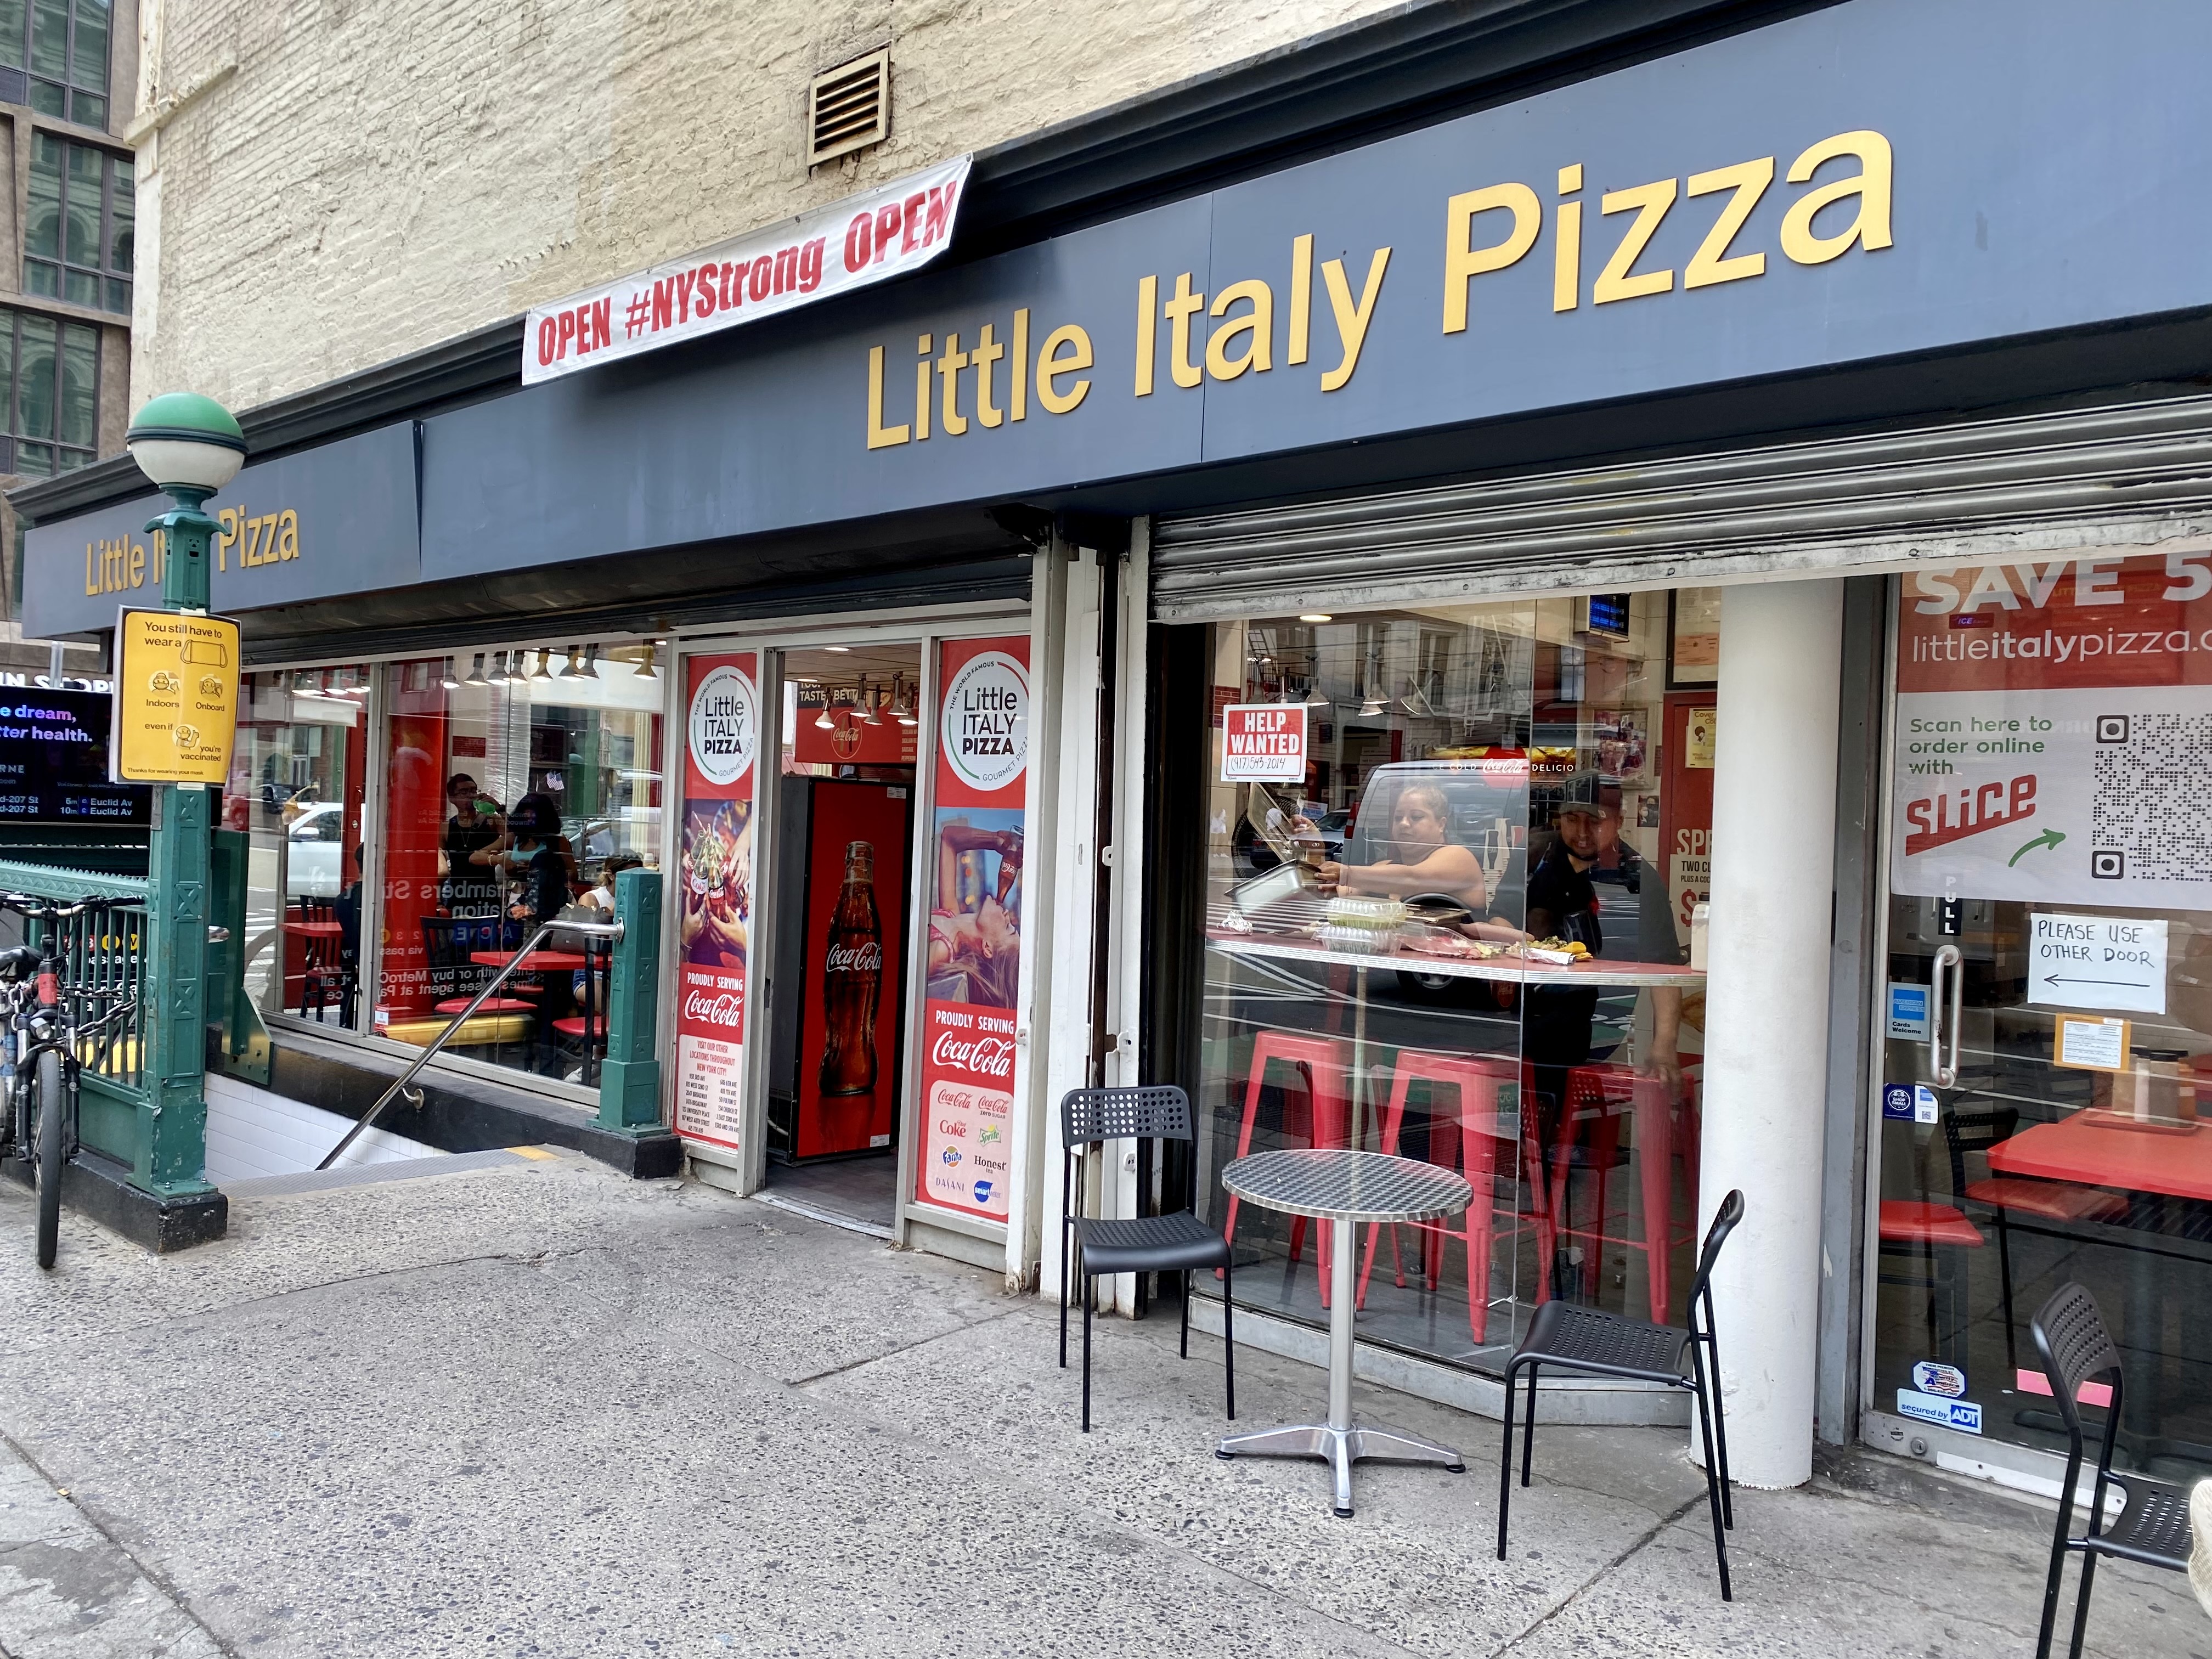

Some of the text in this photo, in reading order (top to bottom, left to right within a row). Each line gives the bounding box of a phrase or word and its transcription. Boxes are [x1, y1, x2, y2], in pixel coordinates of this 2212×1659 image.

[538, 180, 957, 366] OPEN #NYStrong OPEN
[867, 130, 1894, 450] Little Italy Pizza
[86, 534, 145, 596] Little
[219, 505, 300, 571] Pizza
[1914, 553, 2125, 615] SAVE
[145, 622, 222, 638] You still have to
[145, 637, 182, 647] wear a
[955, 672, 971, 693] WORLD
[971, 661, 994, 675] FAMOUS
[698, 684, 711, 702] WORLD
[710, 674, 727, 685] FAMOUS
[834, 689, 859, 701] BETT
[146, 699, 225, 712] Indoors Onboard
[705, 696, 744, 717] Little
[964, 687, 1017, 712] Little
[15, 704, 76, 723] dream,
[1244, 712, 1287, 732] HELP
[167, 723, 173, 731] if
[704, 718, 744, 737] ITALY
[963, 713, 1017, 735] ITALY
[1910, 715, 2053, 733] Scan here to
[32, 726, 93, 742] health.
[200, 745, 222, 755] you're
[704, 739, 742, 754] PIZZA
[963, 737, 1015, 755] PIZZA
[1231, 733, 1300, 754] WANTED
[1909, 737, 2045, 754] order online
[180, 753, 222, 762] vaccinated
[719, 758, 744, 777] GOURMET
[983, 759, 1016, 781] GOURMET
[1449, 763, 1477, 771] COLD
[1909, 759, 1954, 775] with
[28, 796, 39, 804] St
[27, 805, 38, 814] St
[90, 807, 119, 815] Euclid
[120, 808, 132, 816] Av
[1681, 860, 1699, 872] TWO
[2038, 919, 2144, 944] PLEASE USE
[2040, 945, 2155, 968] OTHER DOOR
[687, 972, 743, 991] PROUDLY SERVING
[684, 989, 744, 1027] Coca-Cola
[935, 1009, 1014, 1035] PROUDLY SERVING
[1892, 1026, 1922, 1035] Welcome
[697, 1040, 729, 1053] VISIT OUR OTHER
[932, 1030, 1017, 1077] Coca-Cola
[690, 1050, 736, 1066] LOCATIONS THROUGHOUT
[697, 1063, 727, 1076] NEW YORK CITY!
[692, 1091, 708, 1100] BROADWAY
[692, 1099, 707, 1108] BROADWAY
[938, 1088, 1009, 1114] Coca-Cola Coca-Cola
[687, 1107, 710, 1118] UNIVERSITY PLACE
[723, 1106, 734, 1114] CHURCH
[939, 1119, 967, 1138] Coke
[979, 1131, 1000, 1144] Sprite
[943, 1150, 1007, 1171] Fanta Honest
[936, 1177, 965, 1193] DASANI
[1901, 1403, 1978, 1425] secured by ADT
